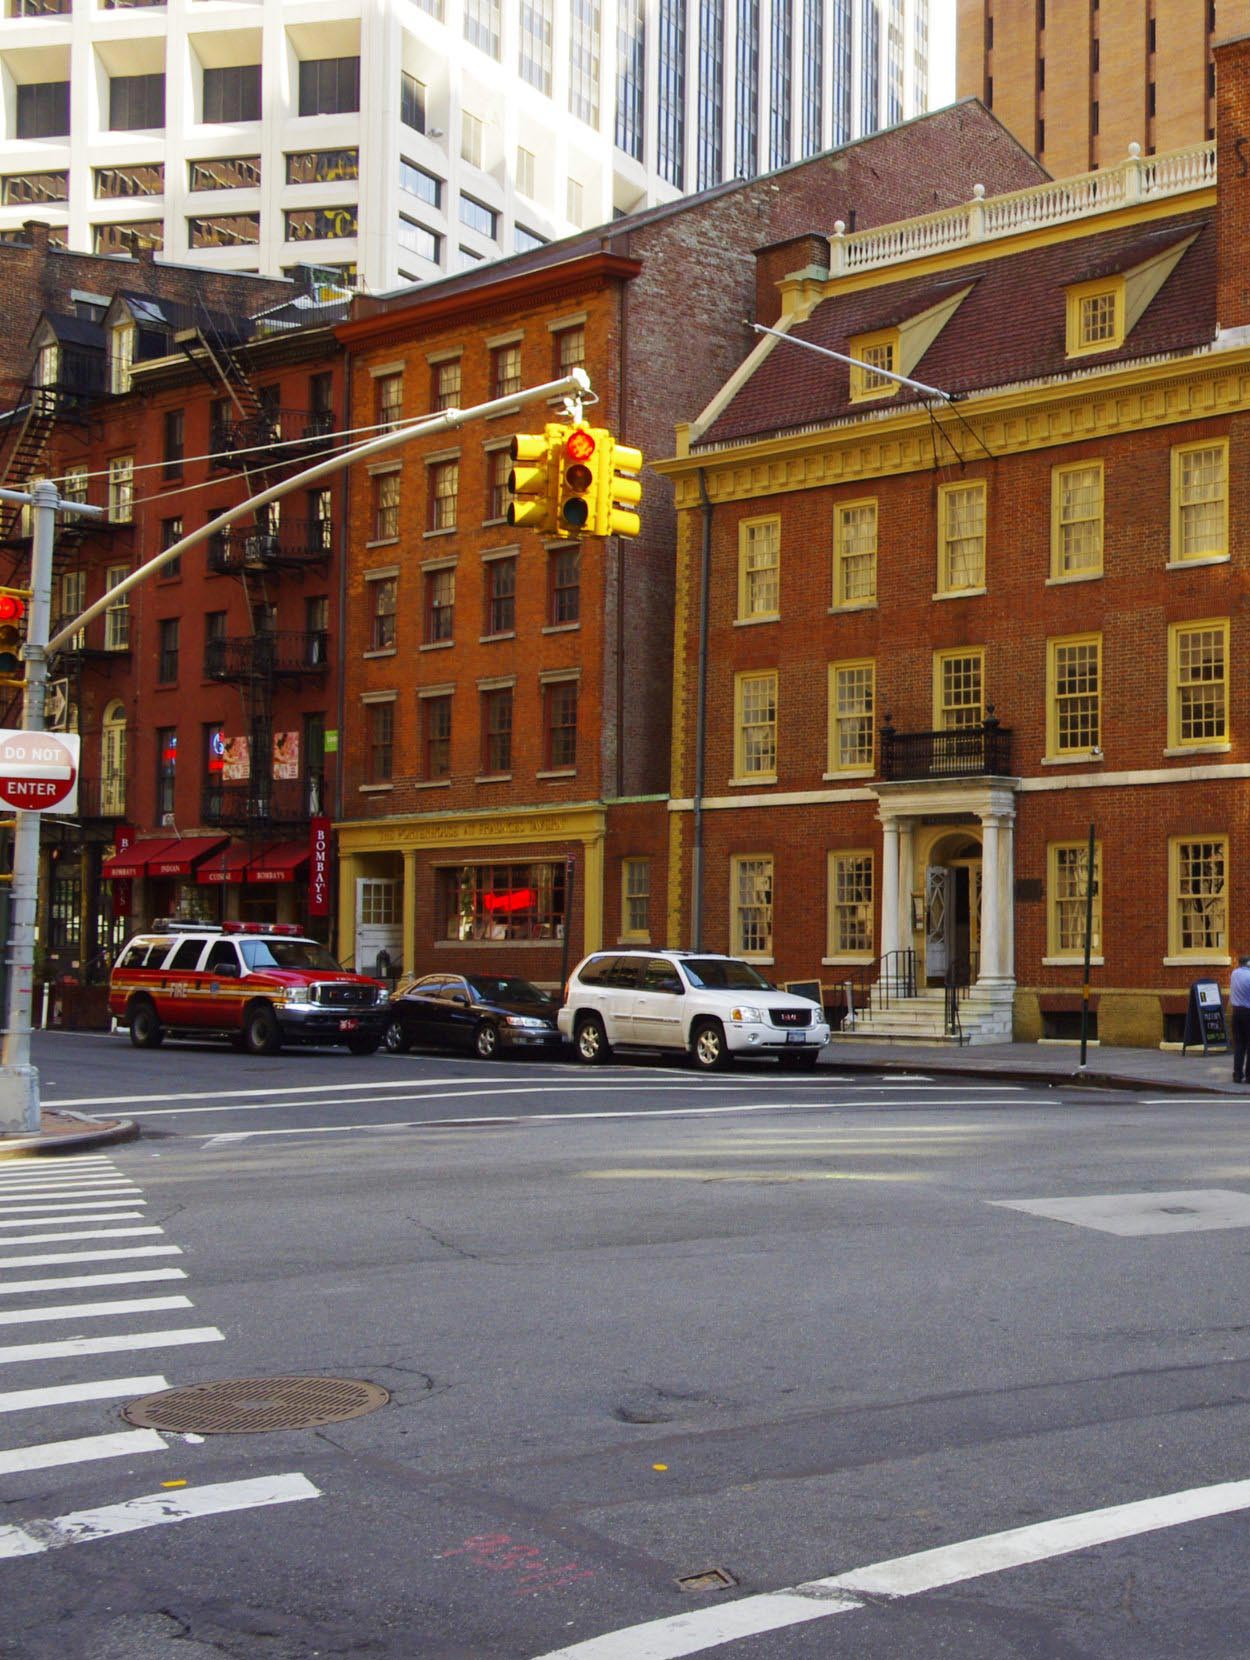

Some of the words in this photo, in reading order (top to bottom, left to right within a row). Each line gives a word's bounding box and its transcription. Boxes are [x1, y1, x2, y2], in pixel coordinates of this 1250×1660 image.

[5, 747, 25, 759] DO
[32, 747, 63, 760] NOT
[8, 782, 56, 795] ENTER
[316, 830, 327, 904] BOMBAY'S
[170, 982, 189, 998] FIRE
